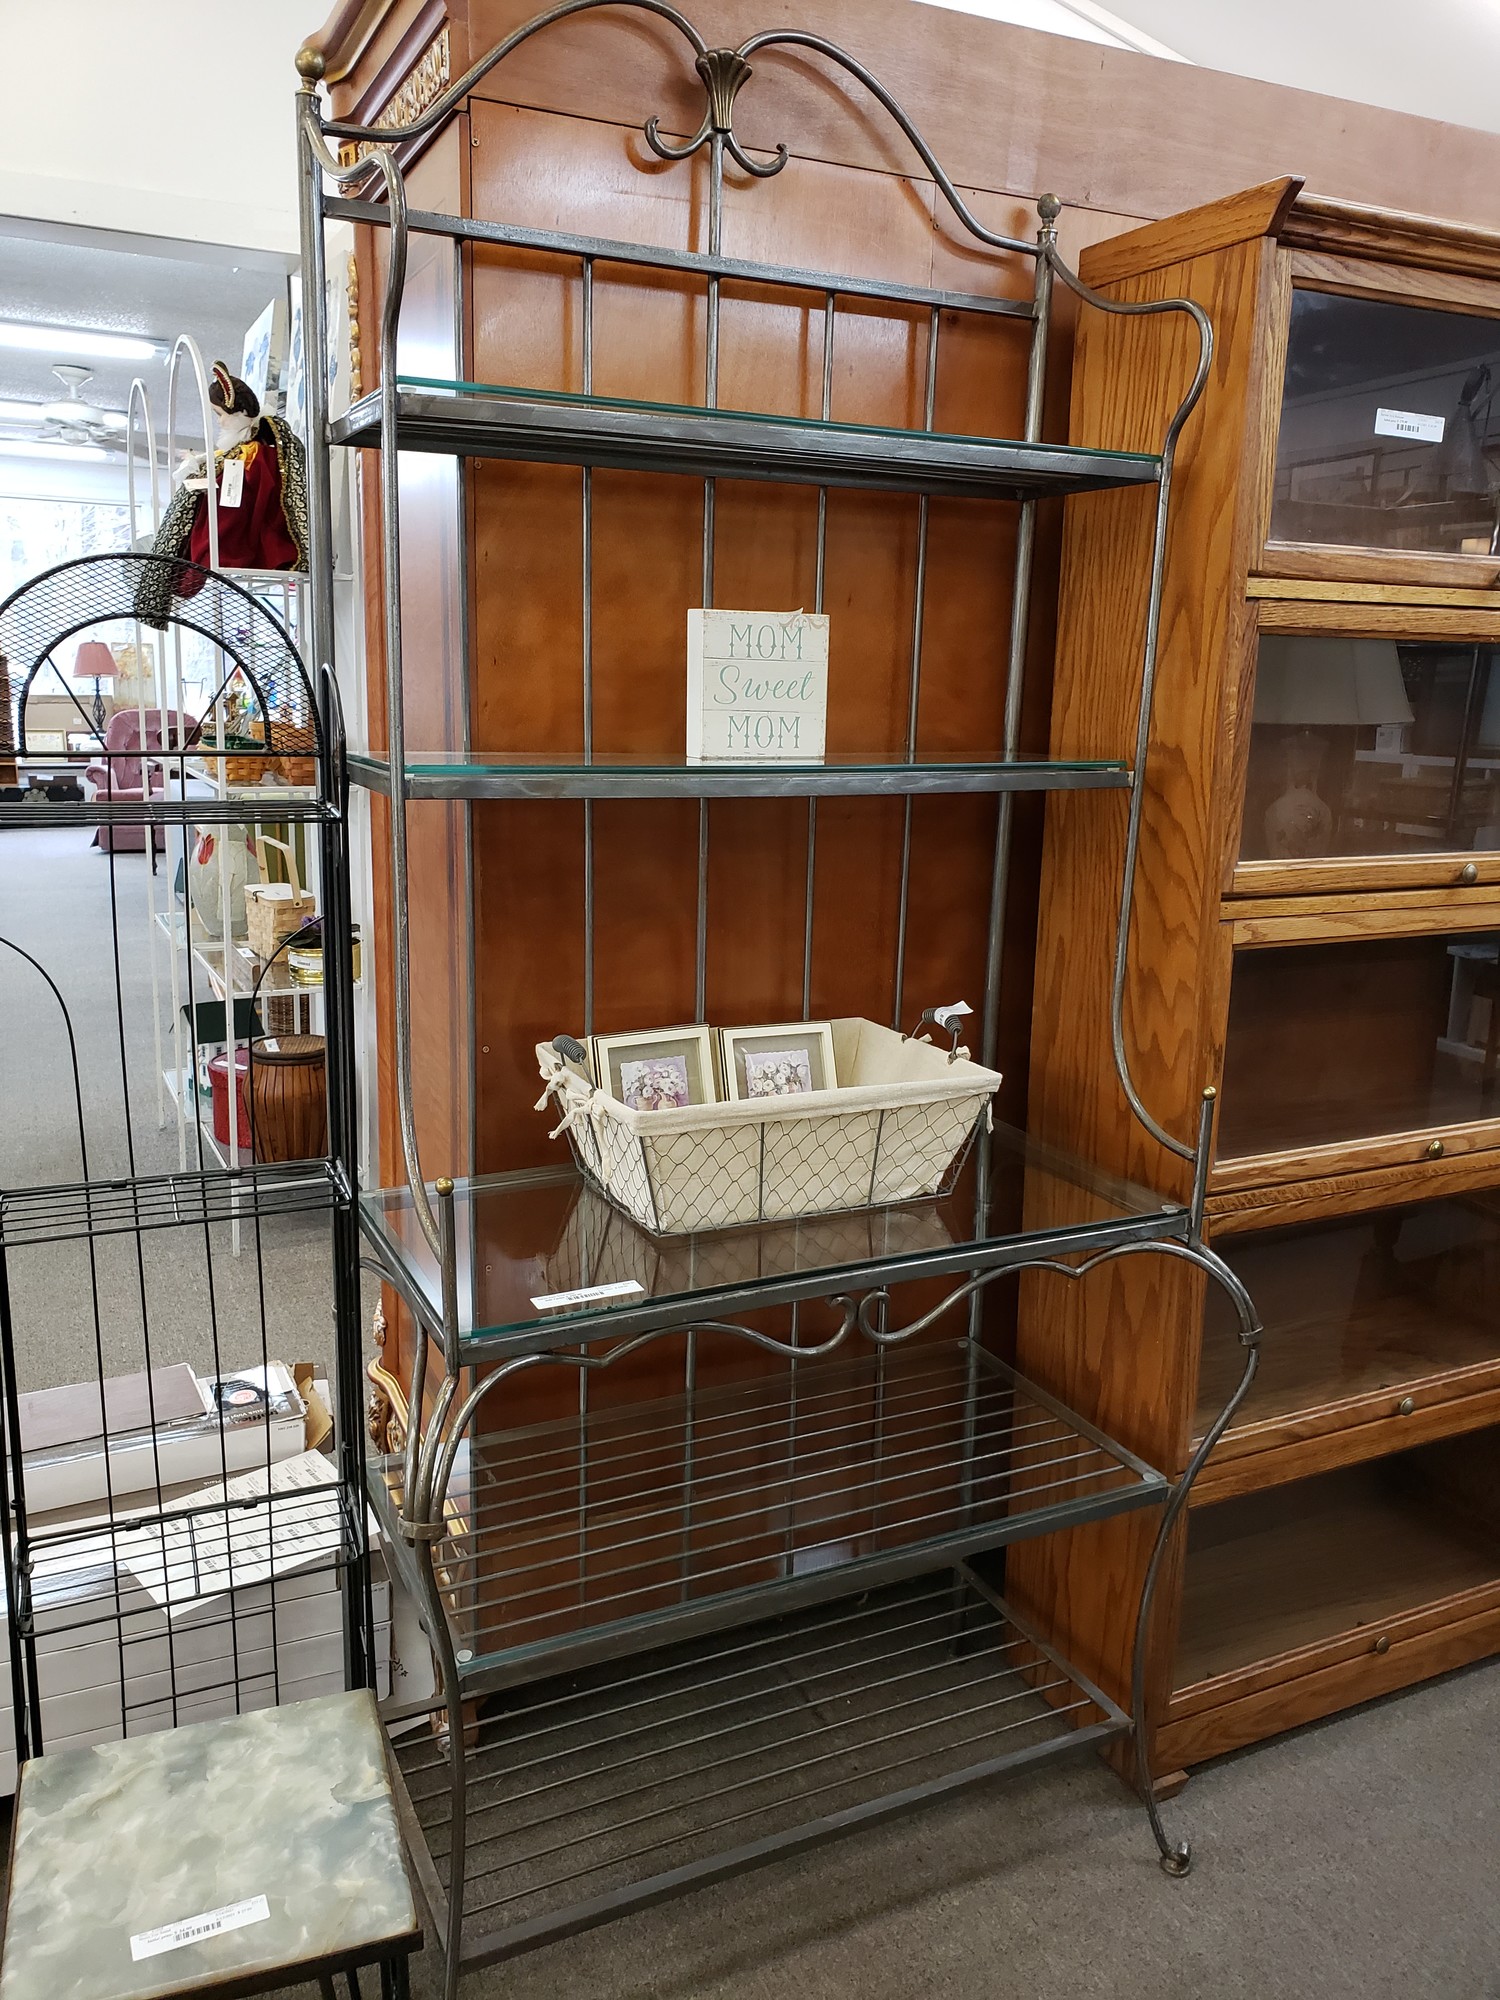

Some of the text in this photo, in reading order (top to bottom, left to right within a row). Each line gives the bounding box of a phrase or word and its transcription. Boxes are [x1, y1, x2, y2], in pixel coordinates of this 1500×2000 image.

[728, 623, 803, 660] MOM
[713, 664, 815, 705] Sweet
[727, 715, 801, 749] MOM
